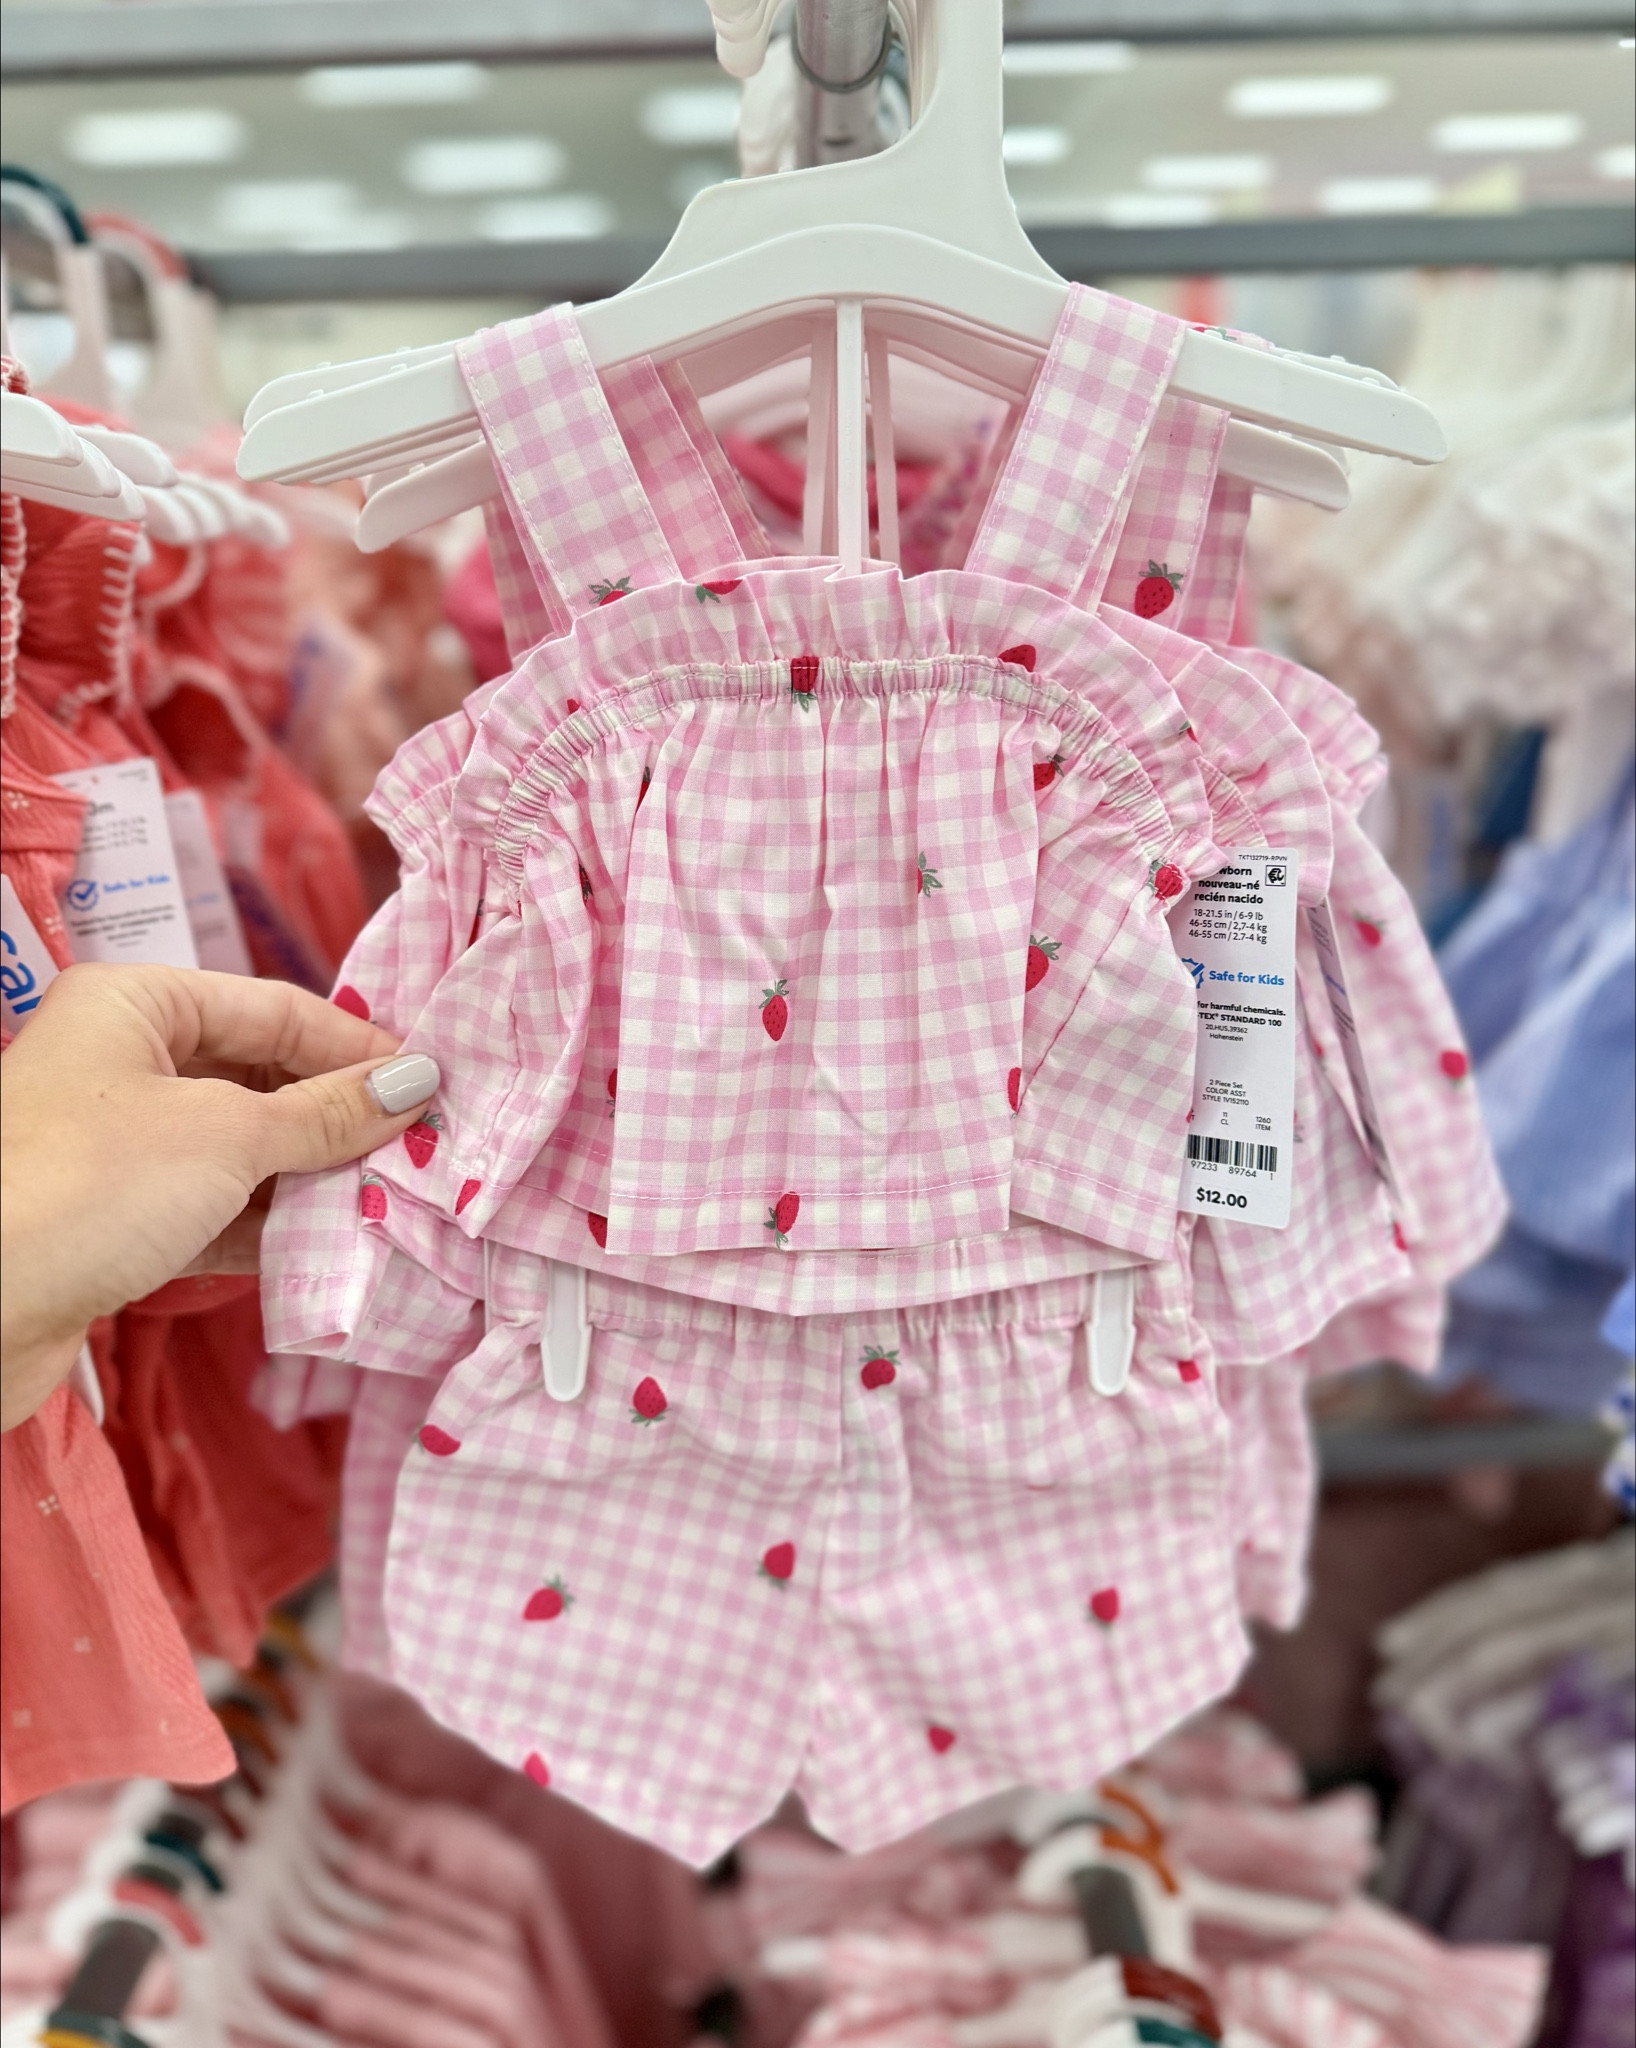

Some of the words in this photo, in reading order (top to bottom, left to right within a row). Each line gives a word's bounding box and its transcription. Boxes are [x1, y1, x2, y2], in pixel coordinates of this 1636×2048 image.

[1198, 880, 1260, 890] nouveau-né
[1194, 892, 1225, 902] recién
[1228, 894, 1263, 904] nacido
[1194, 909, 1222, 918] 18-21.5
[1224, 911, 1232, 919] in
[1239, 911, 1254, 920] 6-9
[1255, 912, 1264, 921] lb
[1189, 919, 1212, 928] 46-55
[1233, 922, 1255, 931] 2,7-4
[1257, 924, 1268, 934] kg
[1188, 929, 1212, 939] 46-55
[1214, 932, 1226, 940] cm
[1233, 932, 1254, 941] 2.7-4
[1257, 934, 1268, 944] kg
[1209, 971, 1235, 982] Safe
[1237, 973, 1256, 983] for
[1258, 974, 1285, 986] Kids
[1197, 1001, 1209, 1009] for
[1210, 1002, 1242, 1012] harmful
[1243, 1006, 1286, 1016] chemicals.
[1220, 1015, 1266, 1025] STANDARD
[1268, 1018, 1282, 1027] 100
[1209, 1033, 1244, 1042] Hohenstein
[1215, 1079, 1231, 1088] Piece
[1233, 1081, 1243, 1089] Set
[1202, 1094, 1222, 1103] STYLE
[1205, 1087, 1229, 1096] COLOR
[1230, 1089, 1247, 1098] ASST
[1256, 1116, 1271, 1124] 1260
[1255, 1123, 1271, 1131] ITEM
[1190, 1160, 1218, 1172] 97233
[1228, 1166, 1257, 1178] 89764
[1196, 1187, 1248, 1208] $12.00
